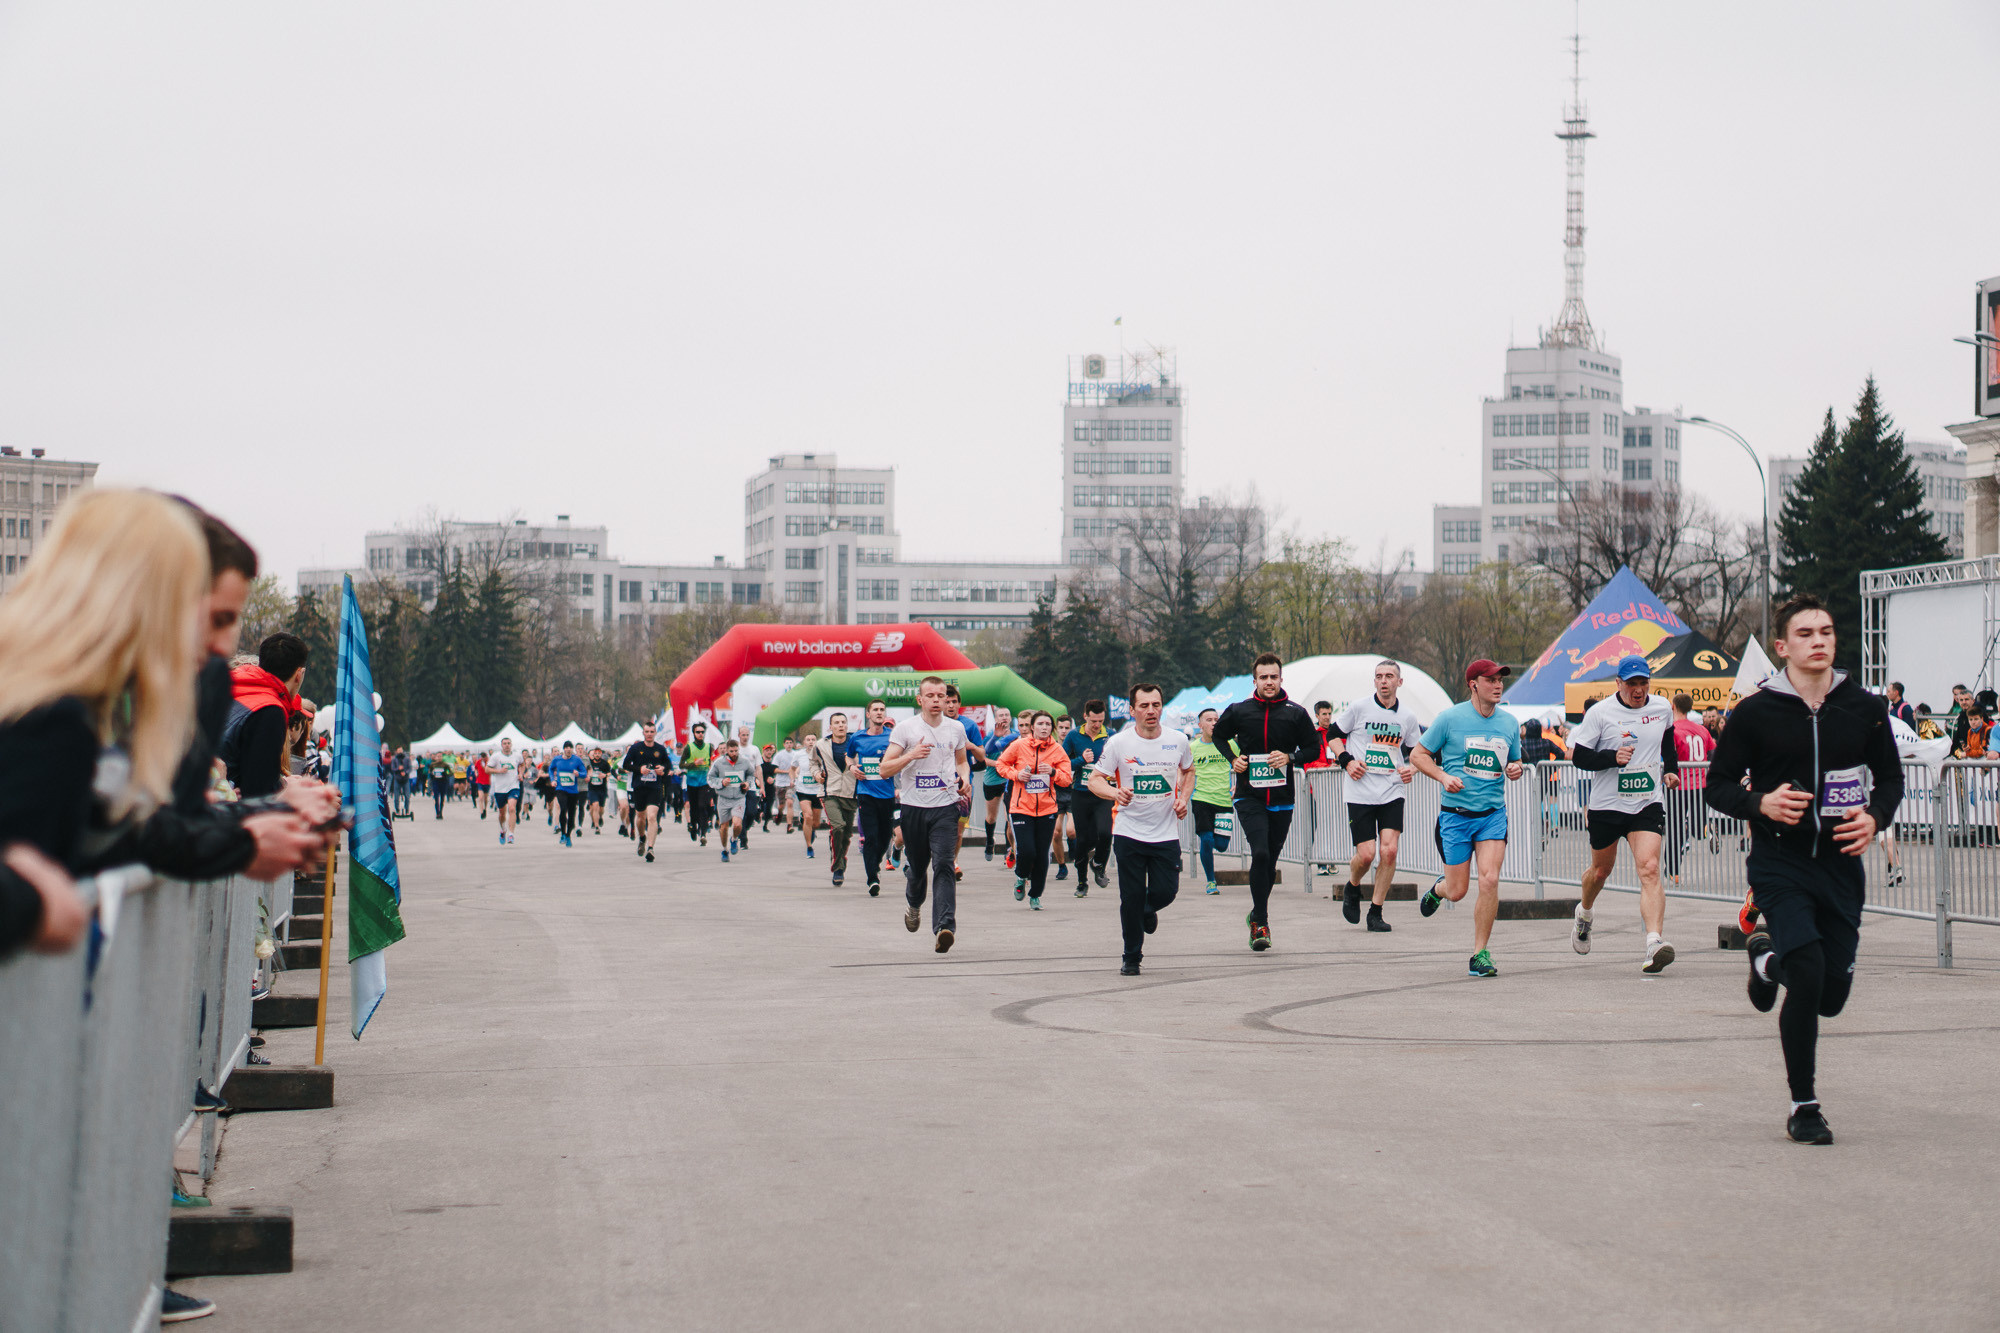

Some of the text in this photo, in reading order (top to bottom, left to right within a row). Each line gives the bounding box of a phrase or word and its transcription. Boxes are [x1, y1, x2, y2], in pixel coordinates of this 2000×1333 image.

[1590, 603, 1681, 630] Red Bull
[764, 640, 863, 654] new balance
[1365, 721, 1389, 732] run
[1374, 731, 1402, 744] with
[1685, 735, 1705, 761] 10
[1365, 754, 1389, 765] 2898
[1468, 753, 1494, 767] 1048
[1252, 767, 1275, 777] 1620
[918, 778, 941, 787] 5287
[1136, 780, 1163, 791] 1975
[1621, 777, 1649, 789] 3102
[1828, 785, 1863, 803] 5389
